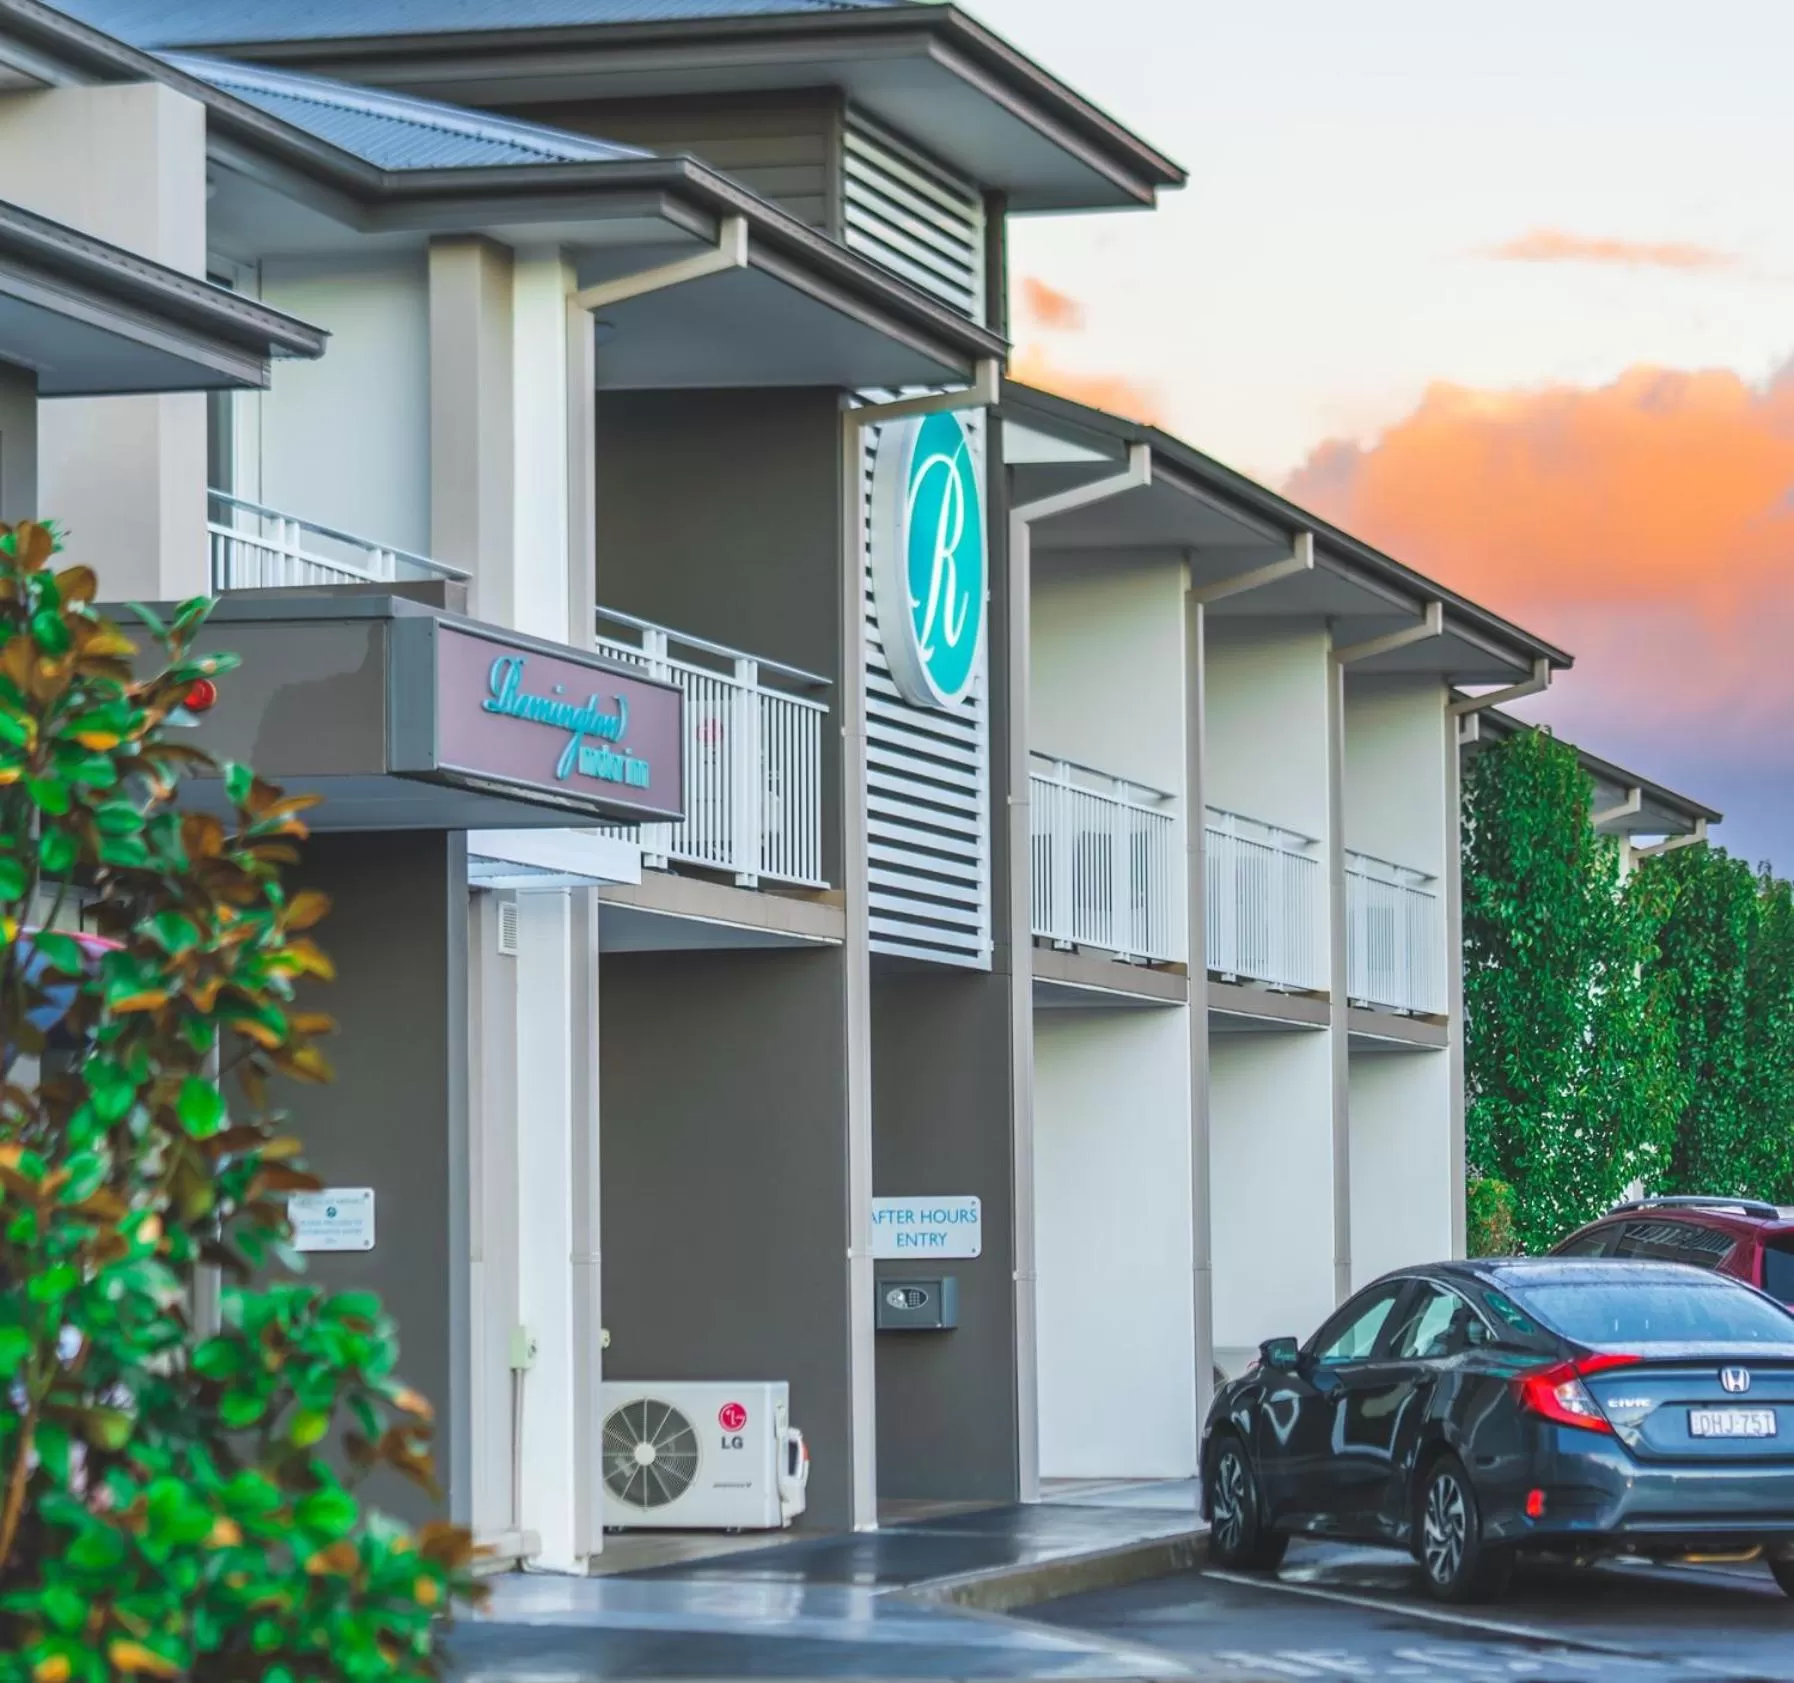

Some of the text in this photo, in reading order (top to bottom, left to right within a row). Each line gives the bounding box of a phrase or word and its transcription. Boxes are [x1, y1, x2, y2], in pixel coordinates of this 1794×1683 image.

[920, 1209, 977, 1224] HOURS
[896, 1232, 947, 1247] ENTRY
[1608, 1398, 1650, 1408] CIVIC
[721, 1436, 744, 1450] LG
